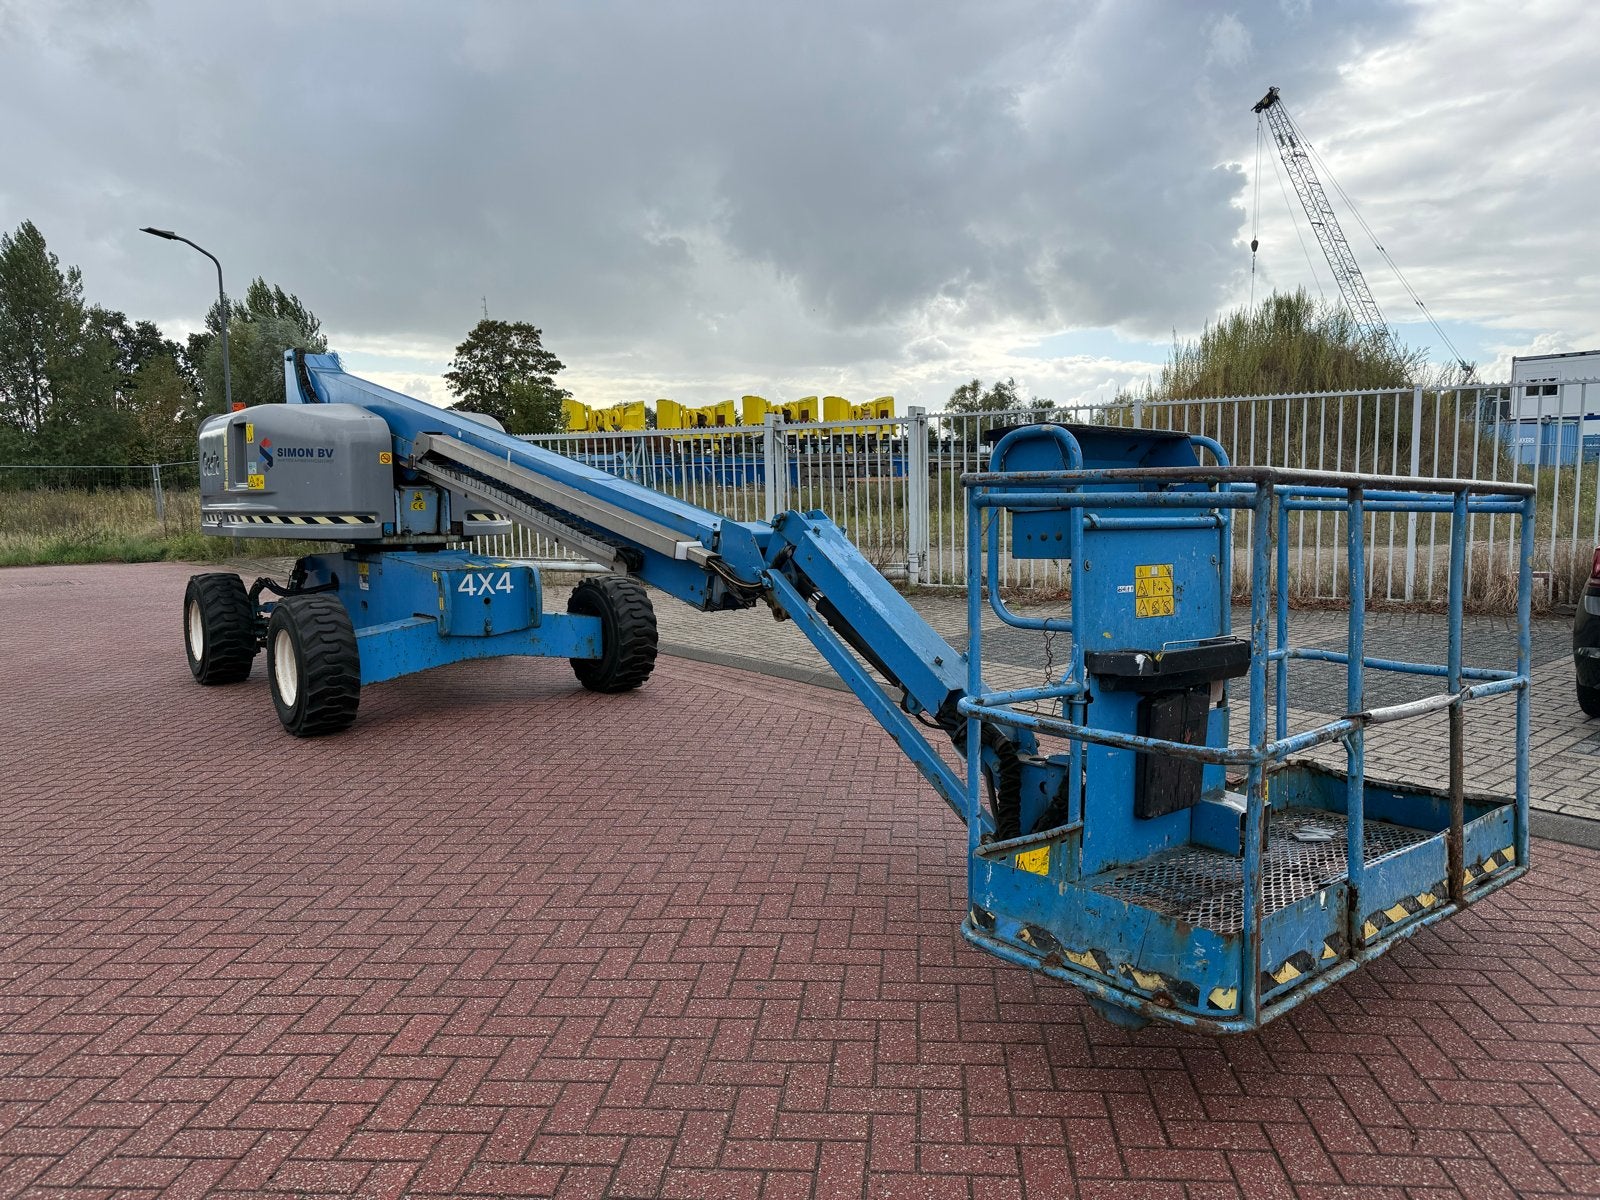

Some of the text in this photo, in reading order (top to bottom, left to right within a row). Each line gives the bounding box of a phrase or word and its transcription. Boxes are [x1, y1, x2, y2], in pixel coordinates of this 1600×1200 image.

[277, 447, 334, 458] SIMON BV
[457, 571, 515, 596] 4X4
